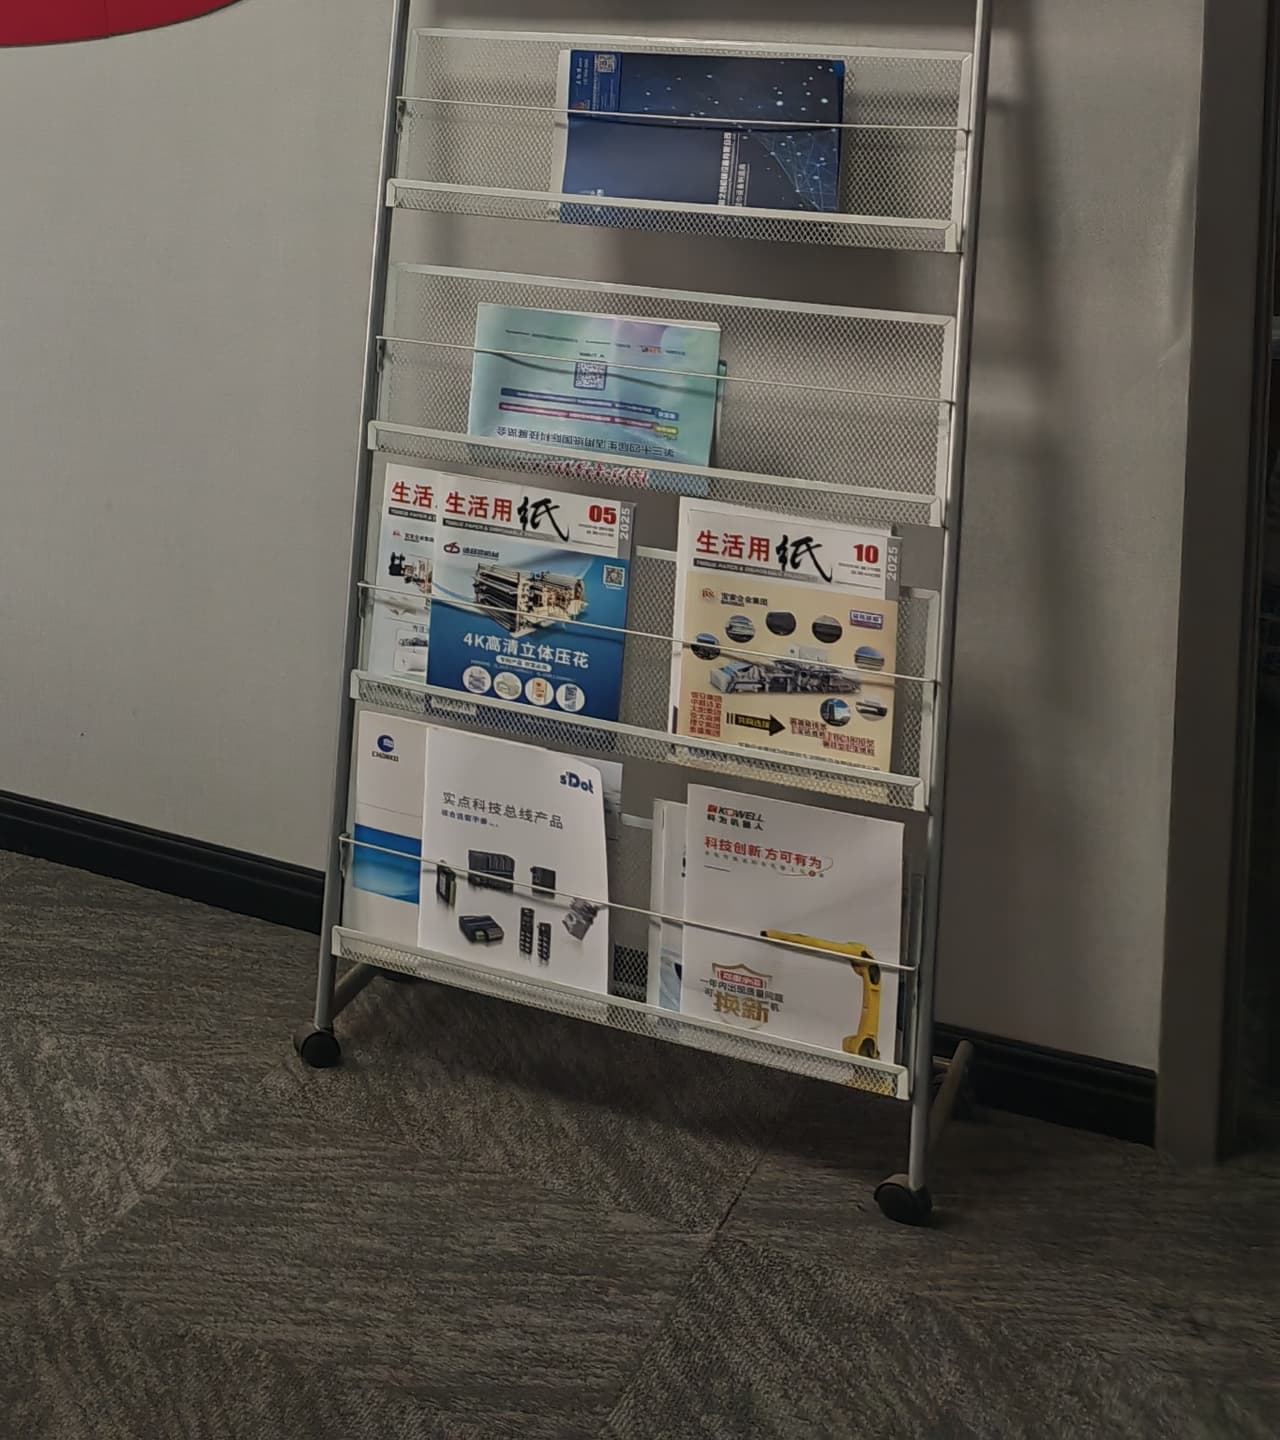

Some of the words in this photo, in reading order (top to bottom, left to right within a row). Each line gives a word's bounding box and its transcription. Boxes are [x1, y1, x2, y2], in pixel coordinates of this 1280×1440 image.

[391, 481, 436, 509] 生活
[445, 491, 569, 542] 生活用纸
[589, 505, 617, 525] 05
[620, 507, 630, 540] 2025
[696, 529, 833, 583] 生活用纸
[853, 544, 879, 564] 10
[886, 546, 898, 581] 2025
[463, 632, 589, 669] 4K高清立体压花
[443, 791, 564, 830] 实点科技总线产品
[704, 836, 761, 858] 科技创新
[765, 848, 822, 869] 方可有为
